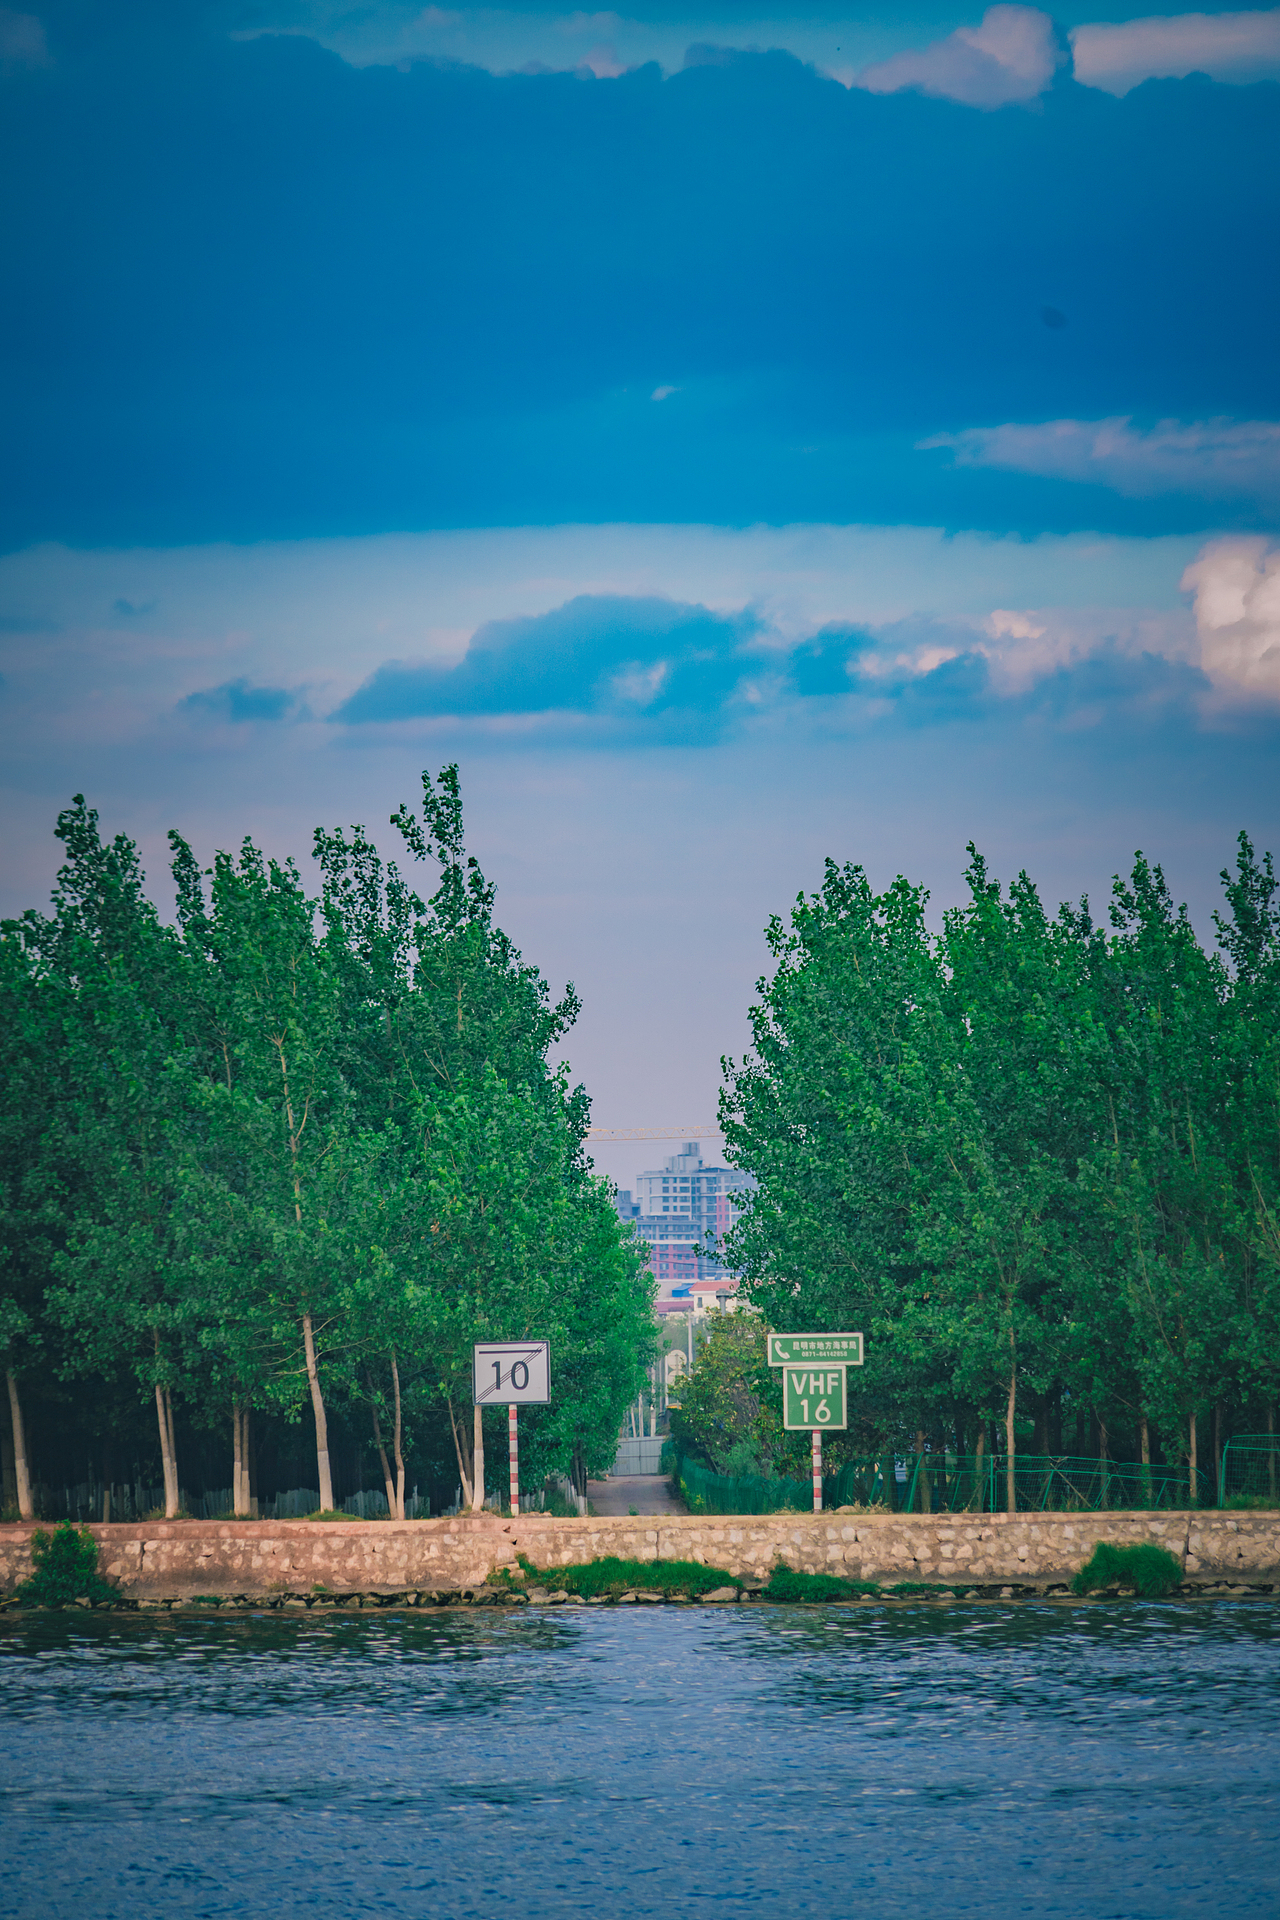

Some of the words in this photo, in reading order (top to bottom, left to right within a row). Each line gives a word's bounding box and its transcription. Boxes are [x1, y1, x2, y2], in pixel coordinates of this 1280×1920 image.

[492, 1361, 529, 1390] 10
[791, 1373, 839, 1395] VHF
[800, 1399, 831, 1423] 16
